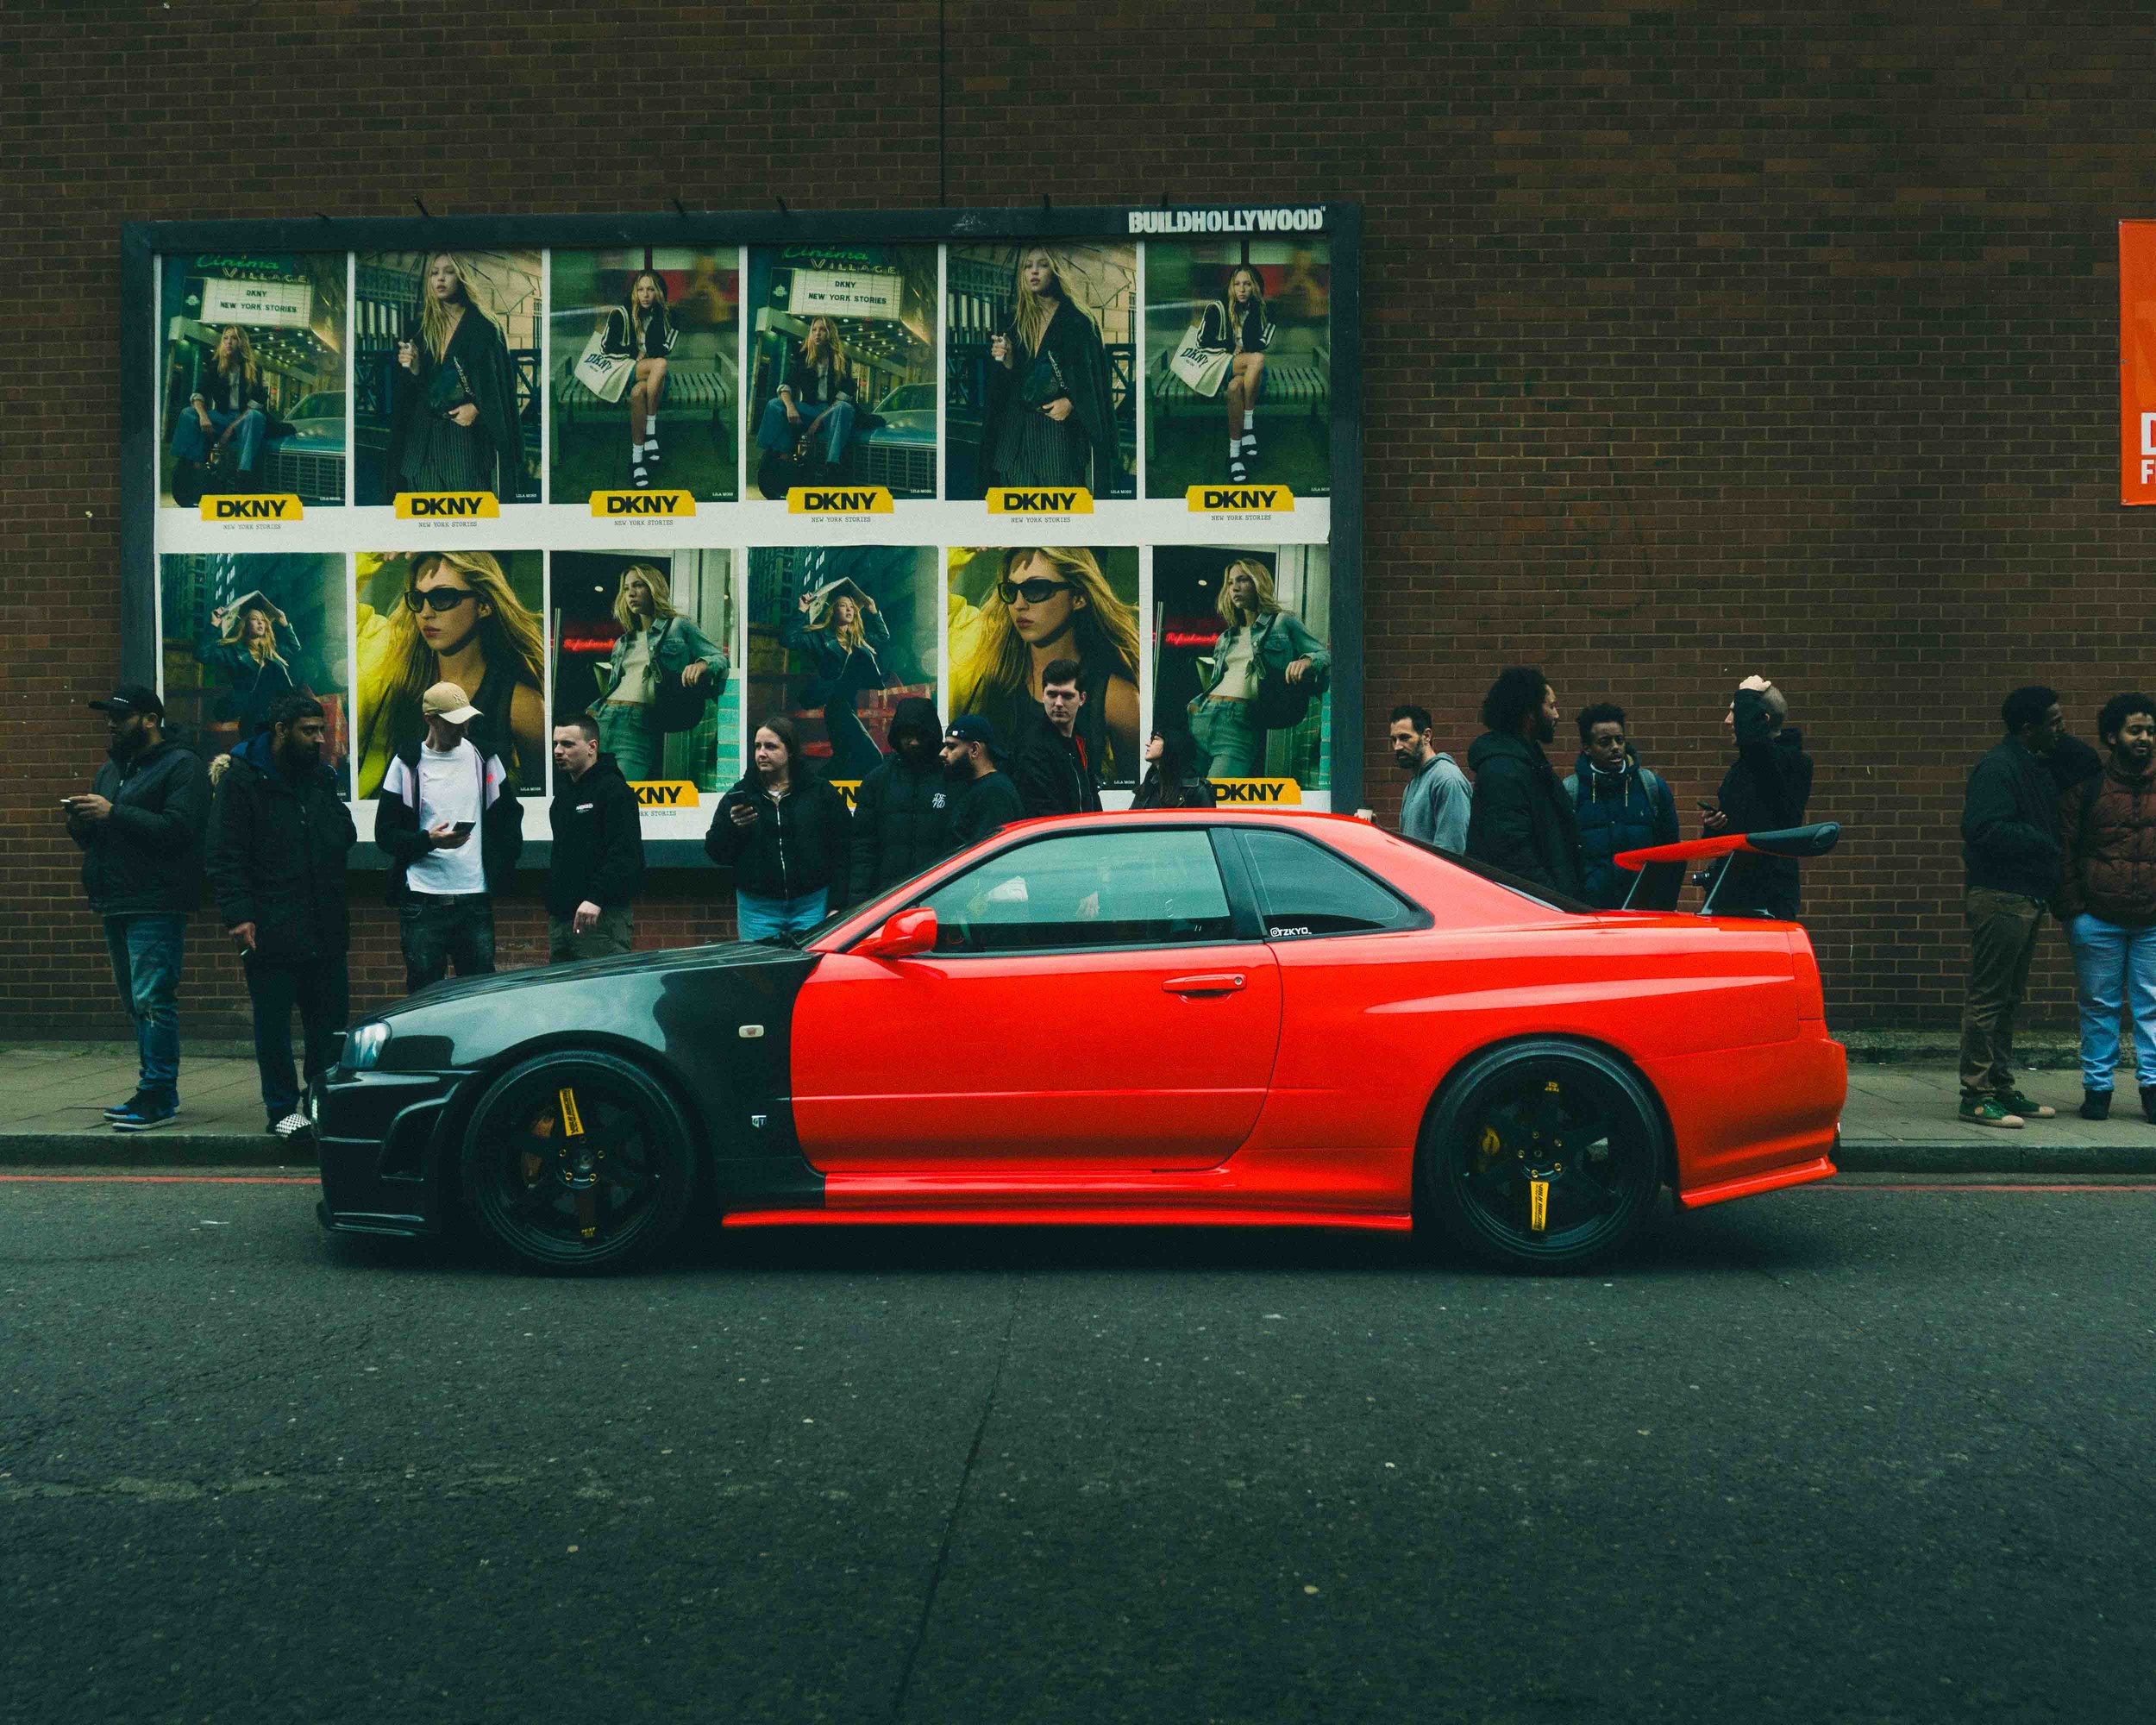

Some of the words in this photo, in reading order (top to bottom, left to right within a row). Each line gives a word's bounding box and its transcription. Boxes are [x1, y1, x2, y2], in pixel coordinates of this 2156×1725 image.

[830, 293, 851, 302] YORK
[855, 296, 887, 304] STORIES
[1180, 348, 1208, 368] DKNY
[411, 497, 483, 516] DKNY
[607, 495, 680, 513] DKNY
[804, 492, 877, 511] DKNY
[1004, 492, 1077, 511] DKNY
[1204, 490, 1277, 508] DKNY
[216, 499, 287, 518] DKNY
[631, 786, 683, 804] KNY
[1214, 783, 1285, 801] DKNY
